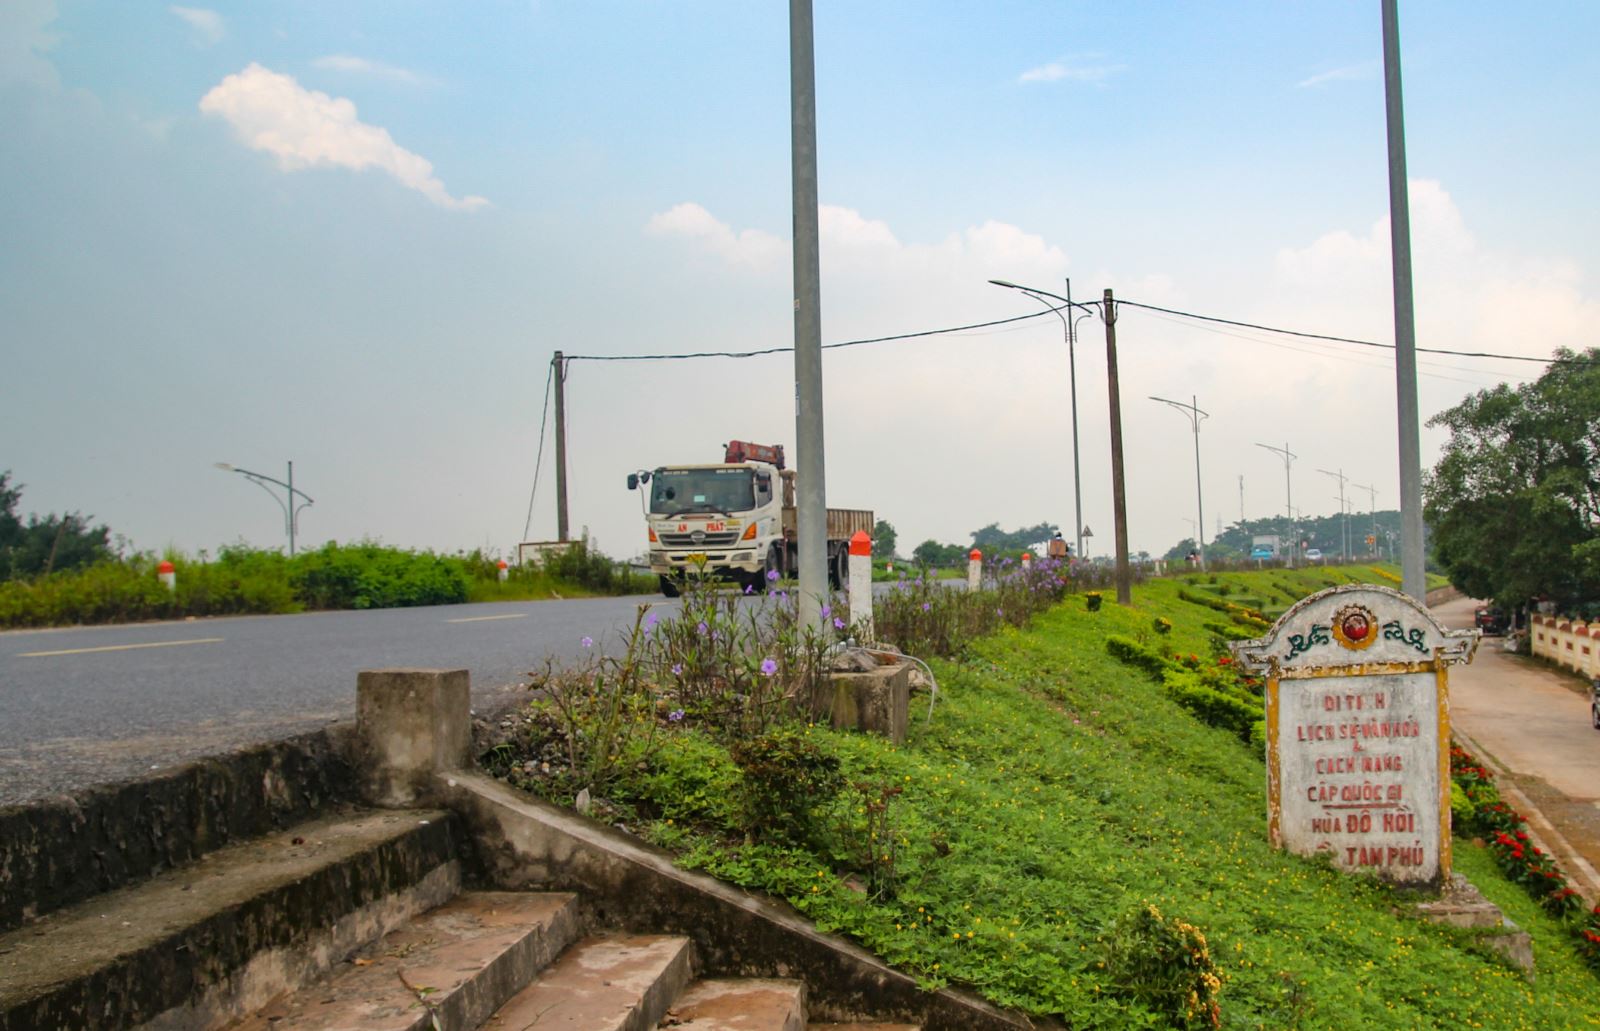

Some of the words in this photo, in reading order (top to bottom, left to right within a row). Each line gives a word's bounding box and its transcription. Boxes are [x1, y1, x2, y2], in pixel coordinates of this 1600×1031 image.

[1324, 695, 1341, 711] DI
[1297, 723, 1335, 744] LỊCH
[1346, 809, 1372, 833] ĐÔ
[1346, 846, 1383, 866] TAM
